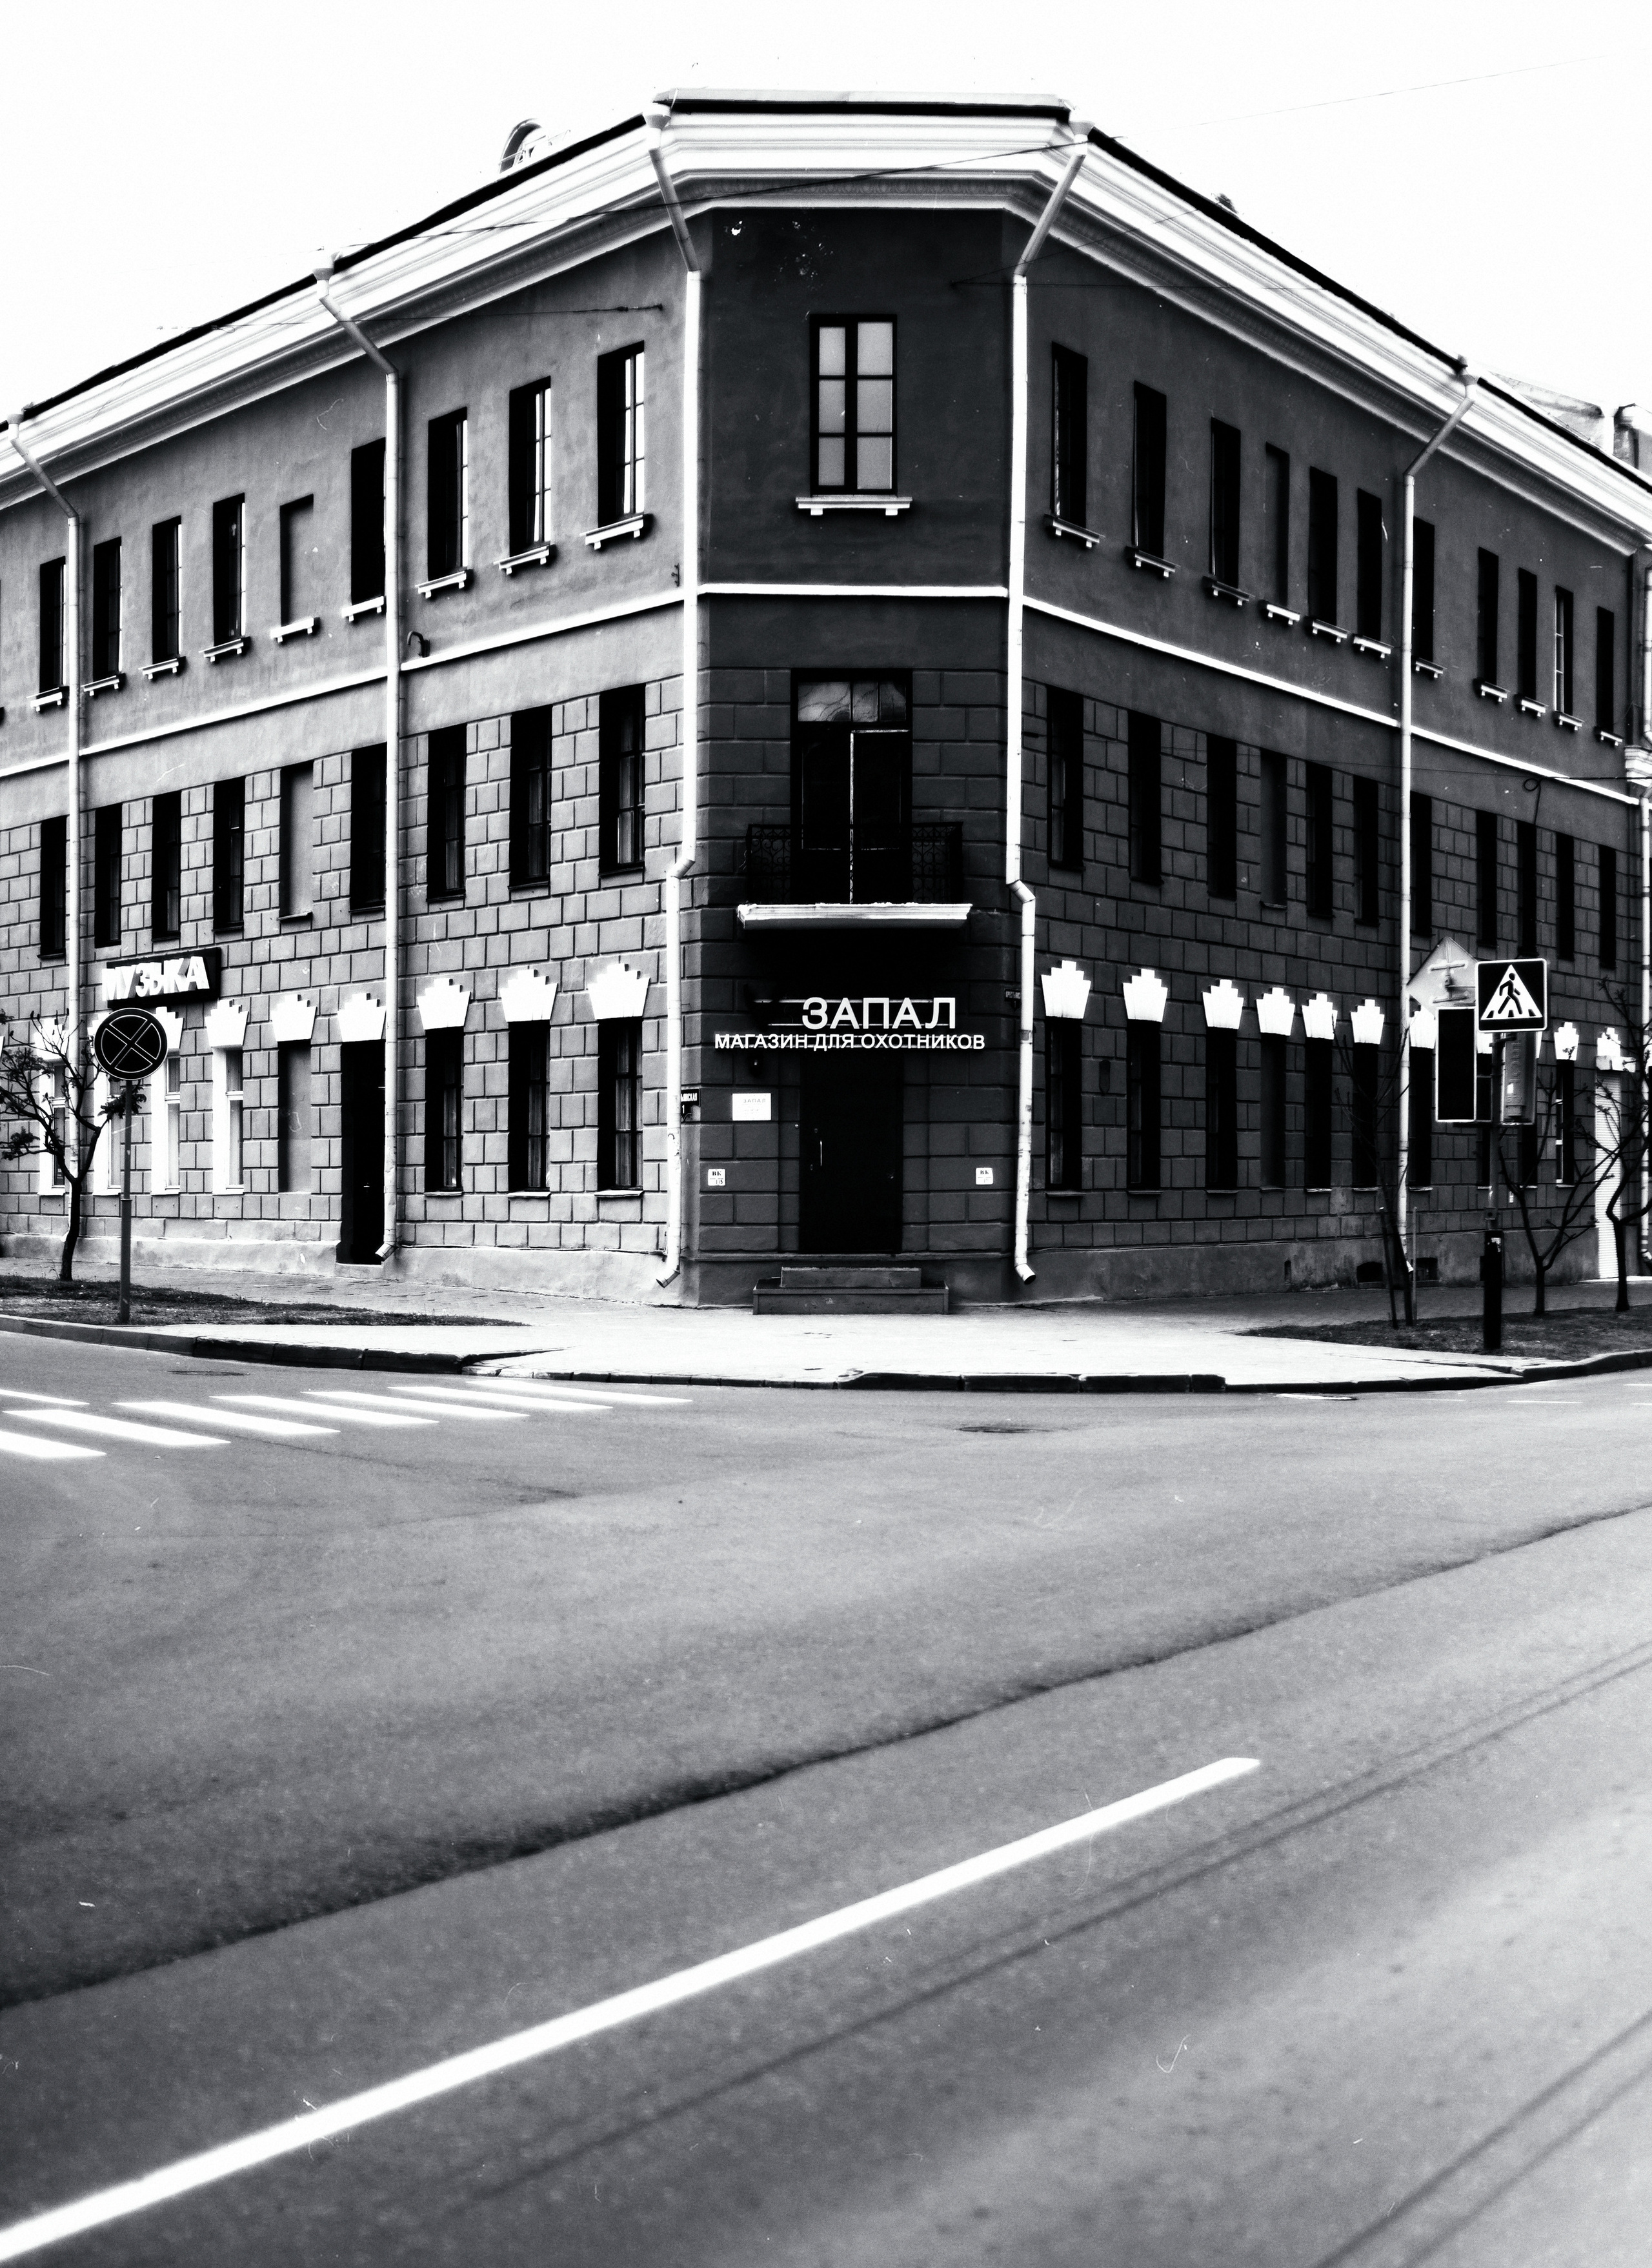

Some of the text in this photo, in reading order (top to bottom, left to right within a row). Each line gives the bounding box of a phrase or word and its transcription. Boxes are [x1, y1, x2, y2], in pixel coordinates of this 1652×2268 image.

[102, 956, 210, 1001] МУЗЫКА
[802, 997, 956, 1030] ЗАПАЛ
[715, 1034, 985, 1052] МАГАЗИН ДЛЯ ОХОТНИКОВ
[681, 1104, 685, 1114] 1
